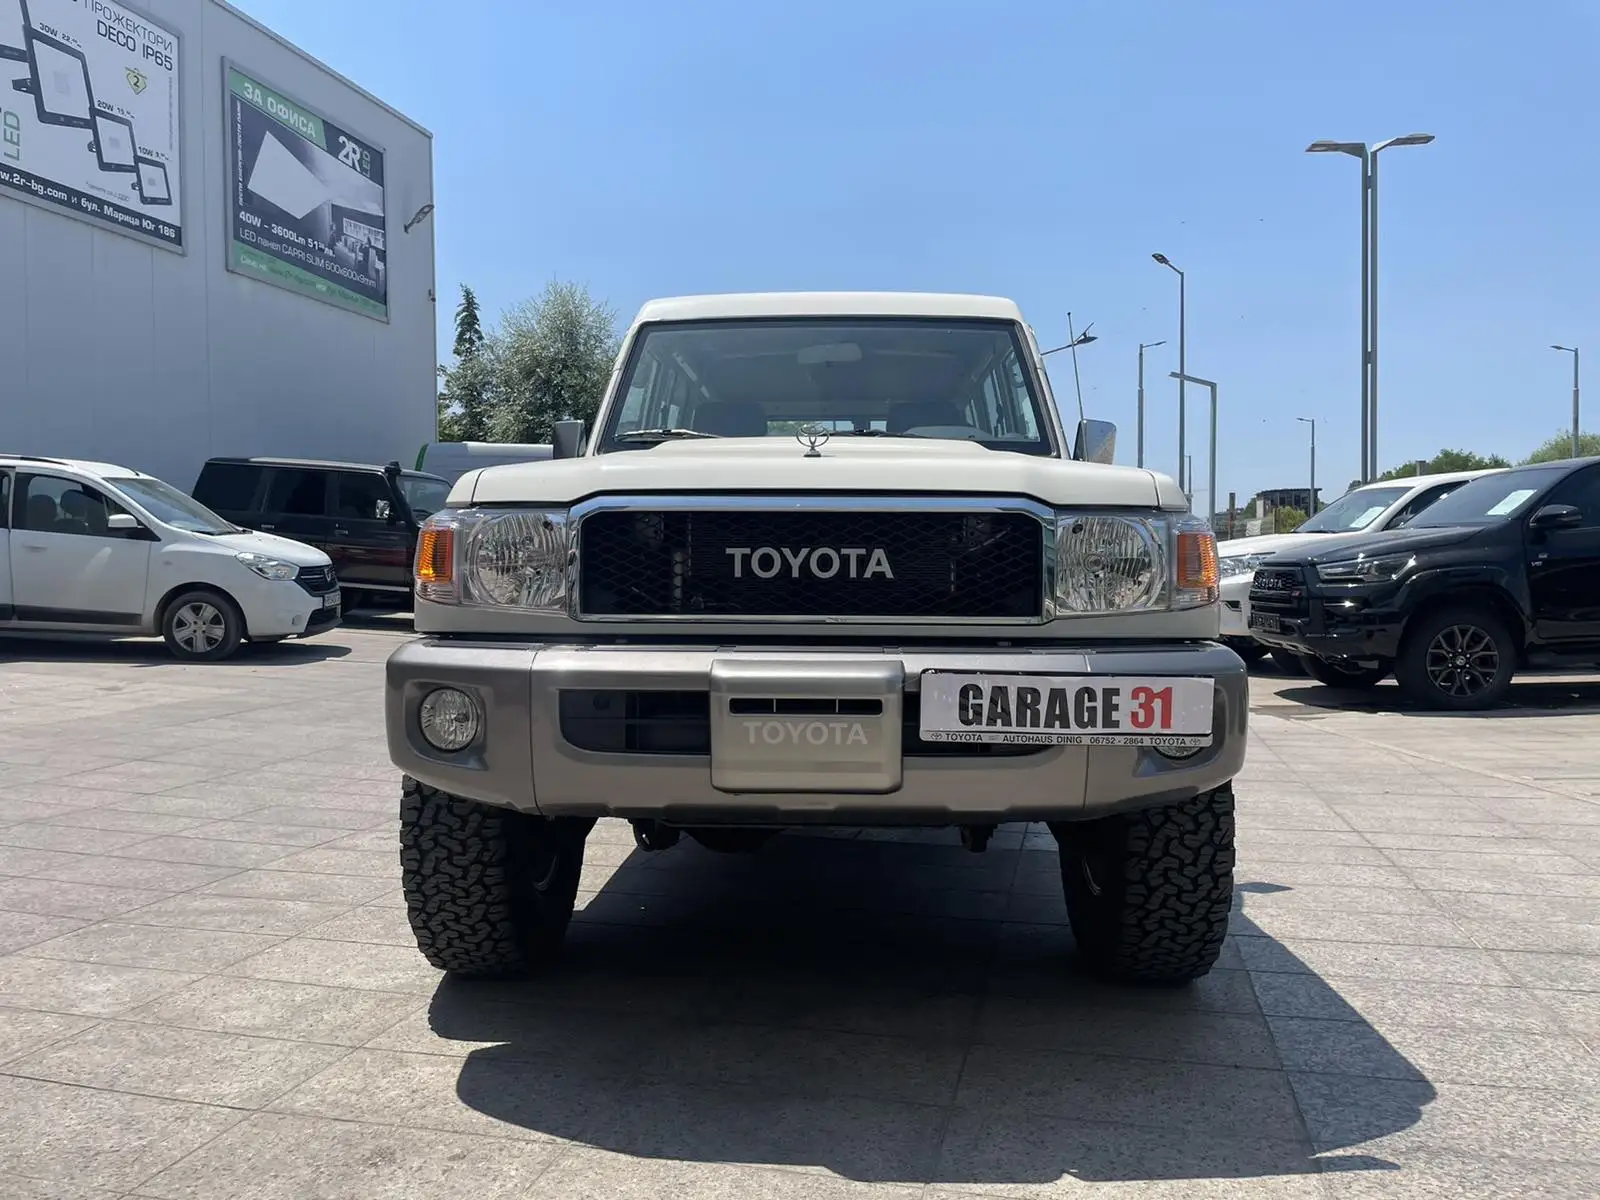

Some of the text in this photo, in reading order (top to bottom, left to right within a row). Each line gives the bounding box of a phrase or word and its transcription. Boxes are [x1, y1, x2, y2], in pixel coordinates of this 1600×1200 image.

[96, 19, 174, 71] DECO IP65
[243, 81, 316, 139] ЗА ОФИСА
[3, 109, 21, 161] LED
[71, 195, 78, 205] и
[80, 196, 101, 212] бул.
[103, 204, 140, 226] Марица
[239, 210, 262, 228] 40W
[239, 227, 257, 242] LED
[725, 546, 895, 580] TOYOTA
[958, 683, 1173, 730] GARAGE 31
[742, 720, 868, 745] TOYOTA
[945, 733, 983, 742] TOYOTA
[1002, 734, 1053, 744] AUTOHAUS
[1149, 737, 1187, 746] TOYOTA
